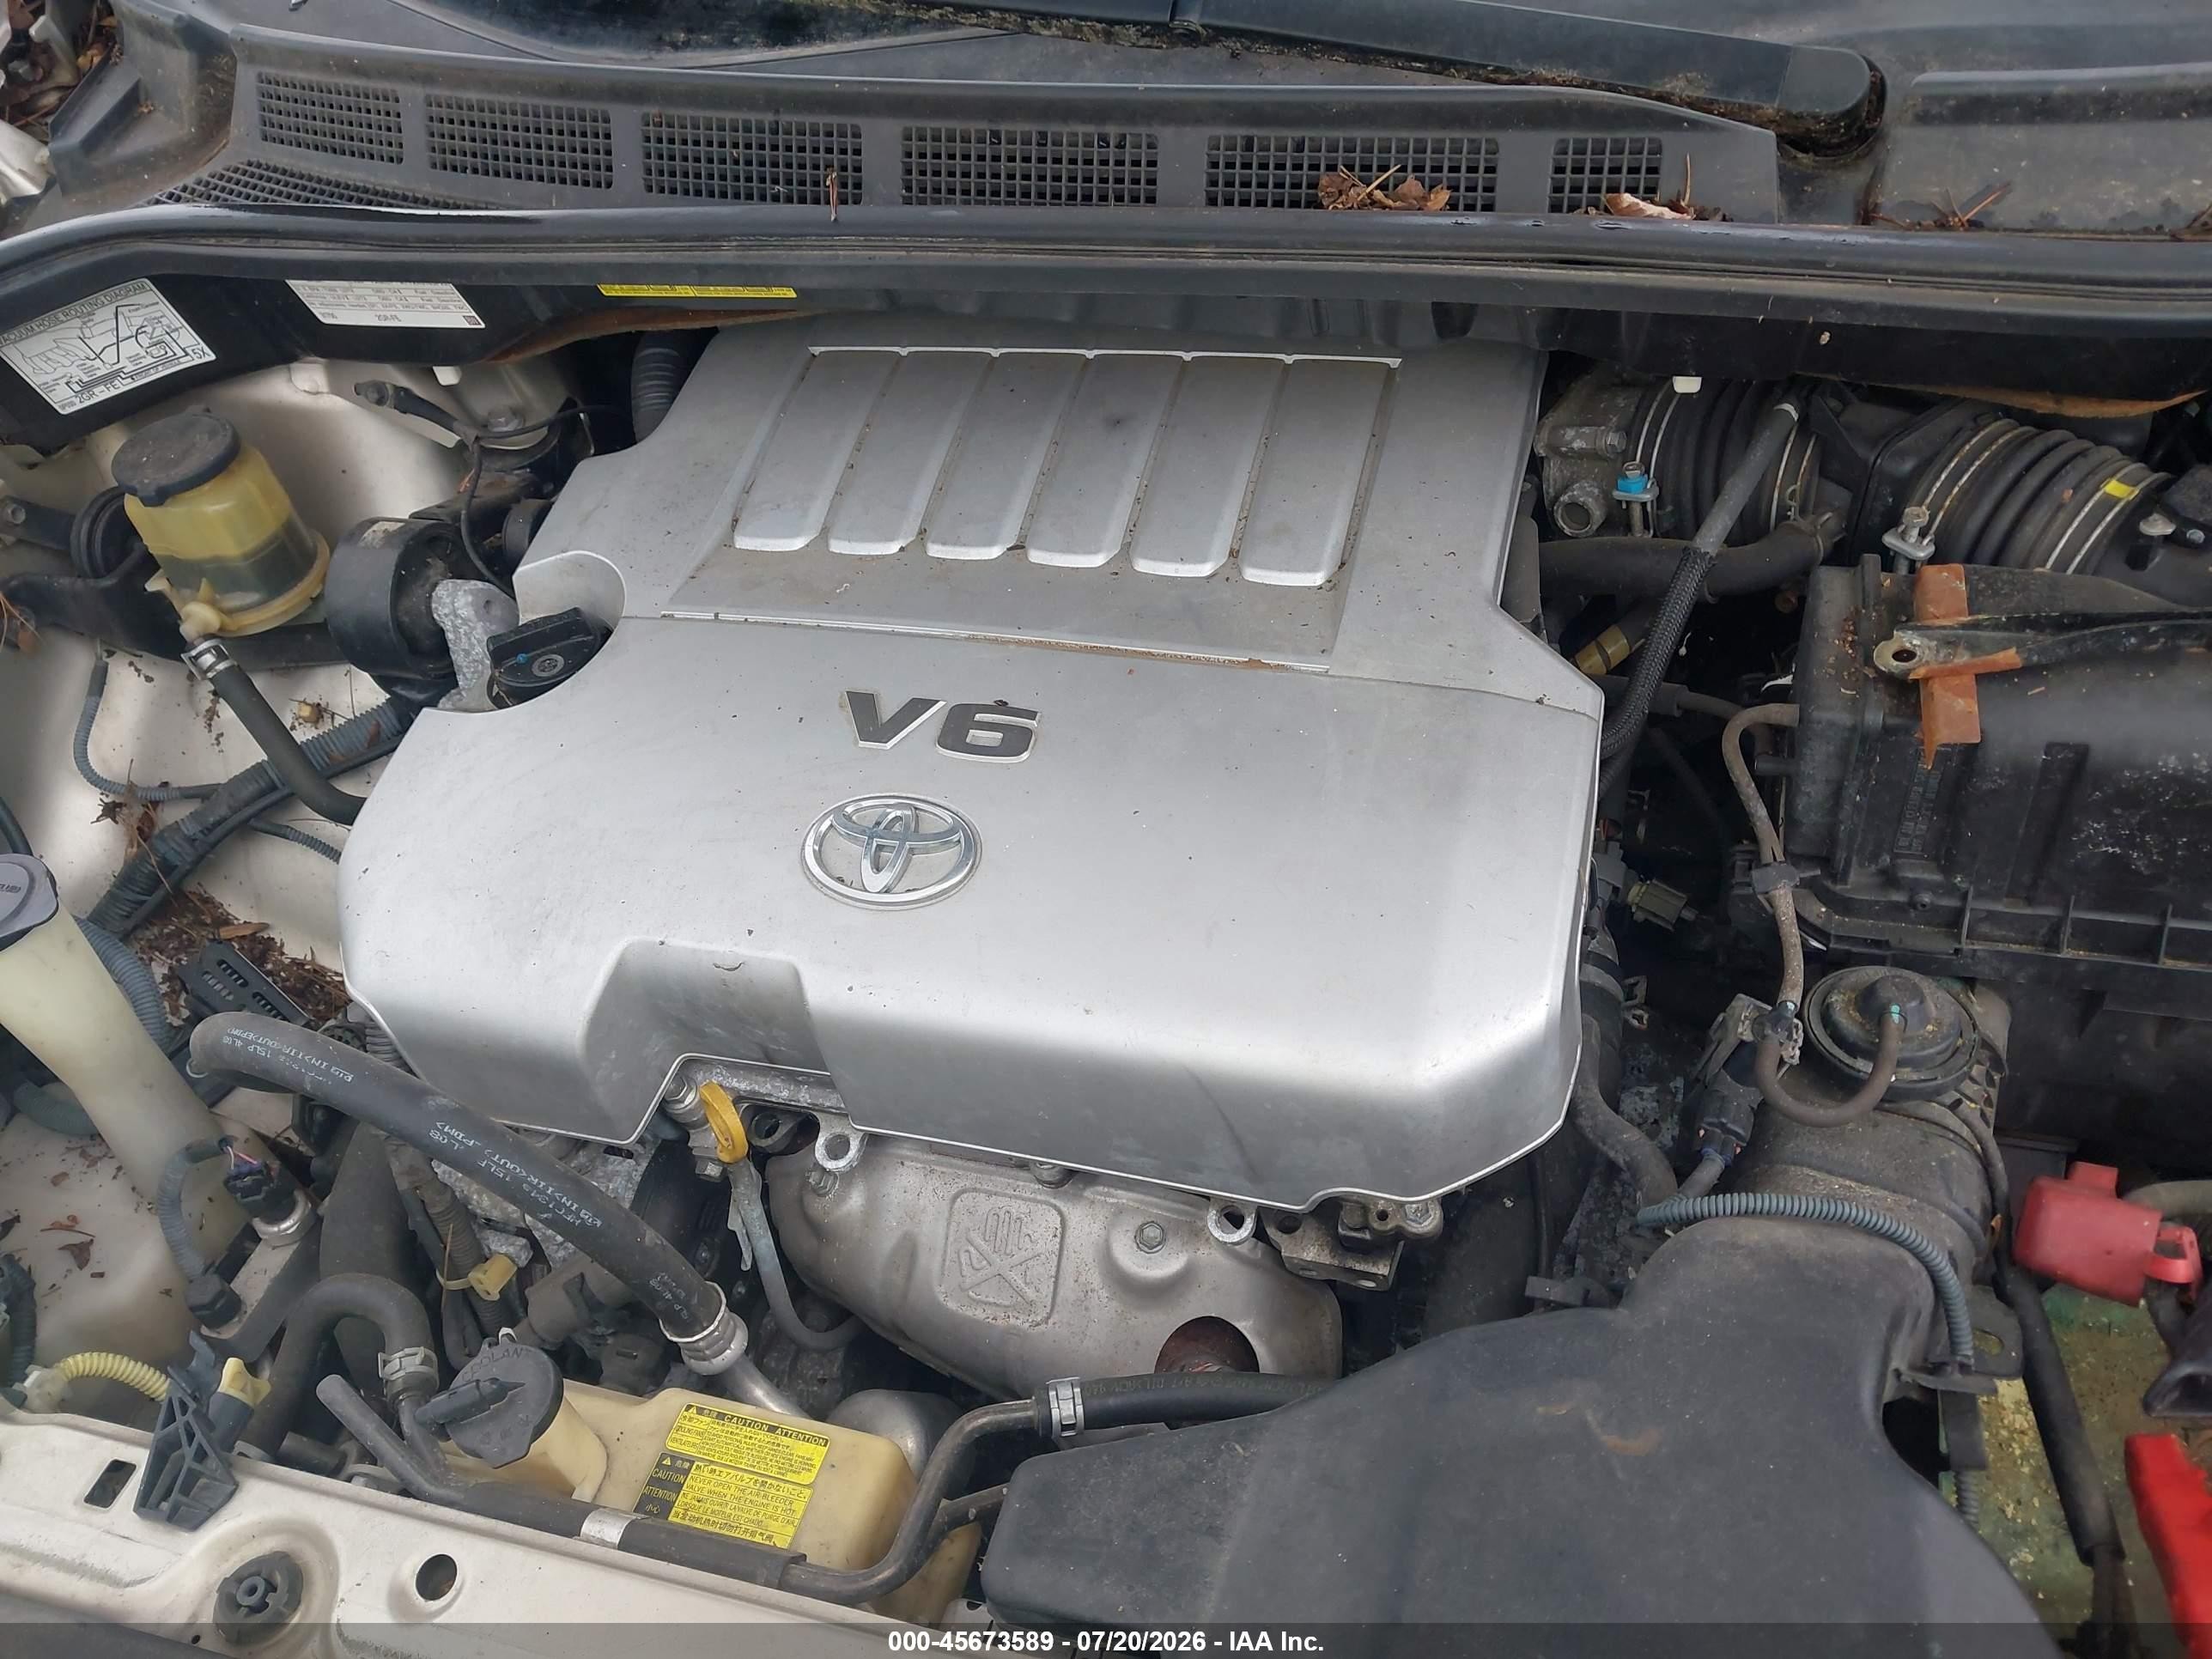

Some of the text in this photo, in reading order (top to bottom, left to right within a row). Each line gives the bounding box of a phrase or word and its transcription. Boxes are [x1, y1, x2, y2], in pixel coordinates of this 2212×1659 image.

[0, 321, 36, 343] ACUUM
[37, 312, 63, 331] HOSE
[64, 298, 105, 318] ROUTING
[105, 283, 146, 302] DIAGRAM
[845, 690, 1042, 763] V6
[724, 1414, 826, 1445] CAUTION ATTENTION
[650, 1468, 686, 1484] CAUTION
[689, 1475, 793, 1507] NEVER OPEN THE AIR BLEEDER
[641, 1485, 678, 1502] ATTENTION
[684, 1483, 706, 1493] VALVE
[705, 1488, 727, 1498] WHEN
[728, 1493, 744, 1503] THE
[743, 1498, 772, 1510] ENGINE
